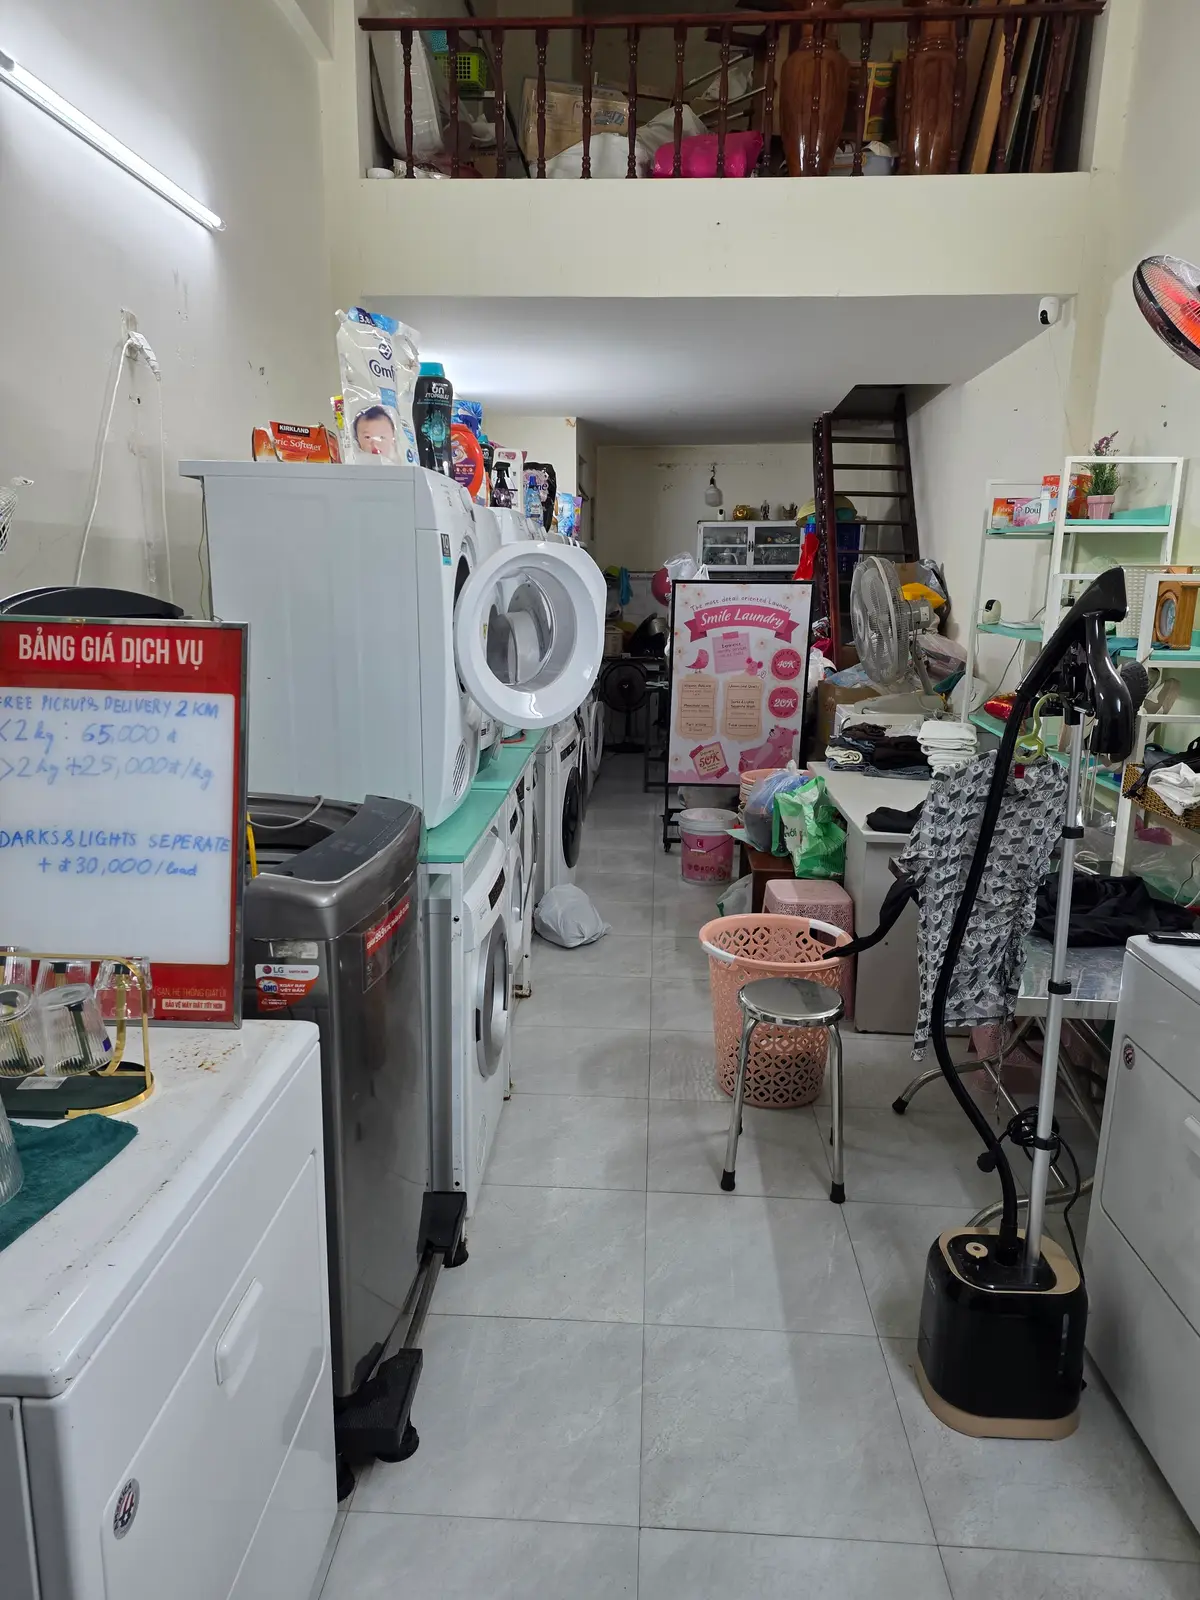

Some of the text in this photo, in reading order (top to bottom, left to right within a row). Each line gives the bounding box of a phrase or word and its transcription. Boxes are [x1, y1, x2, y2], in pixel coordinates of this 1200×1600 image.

[368, 359, 396, 382] Comf
[279, 424, 309, 434] KIRKLAND
[690, 604, 703, 612] The
[721, 595, 739, 603] detail
[741, 596, 767, 604] oriented
[768, 599, 792, 613] Laundry
[701, 608, 784, 629] Smile Laundry
[18, 626, 204, 671] BẢNG GIÁ DỊCH VỤ
[0, 696, 32, 710] REE
[105, 695, 171, 717] DELIVERY
[175, 699, 187, 717] 2
[192, 702, 219, 719] KM
[773, 698, 797, 708] 20K
[34, 720, 54, 754] kg
[699, 751, 720, 768] 50K
[36, 757, 58, 786] kg
[149, 833, 231, 852] SEPERATE
[273, 966, 284, 974] LG
[263, 984, 277, 992] OMO
